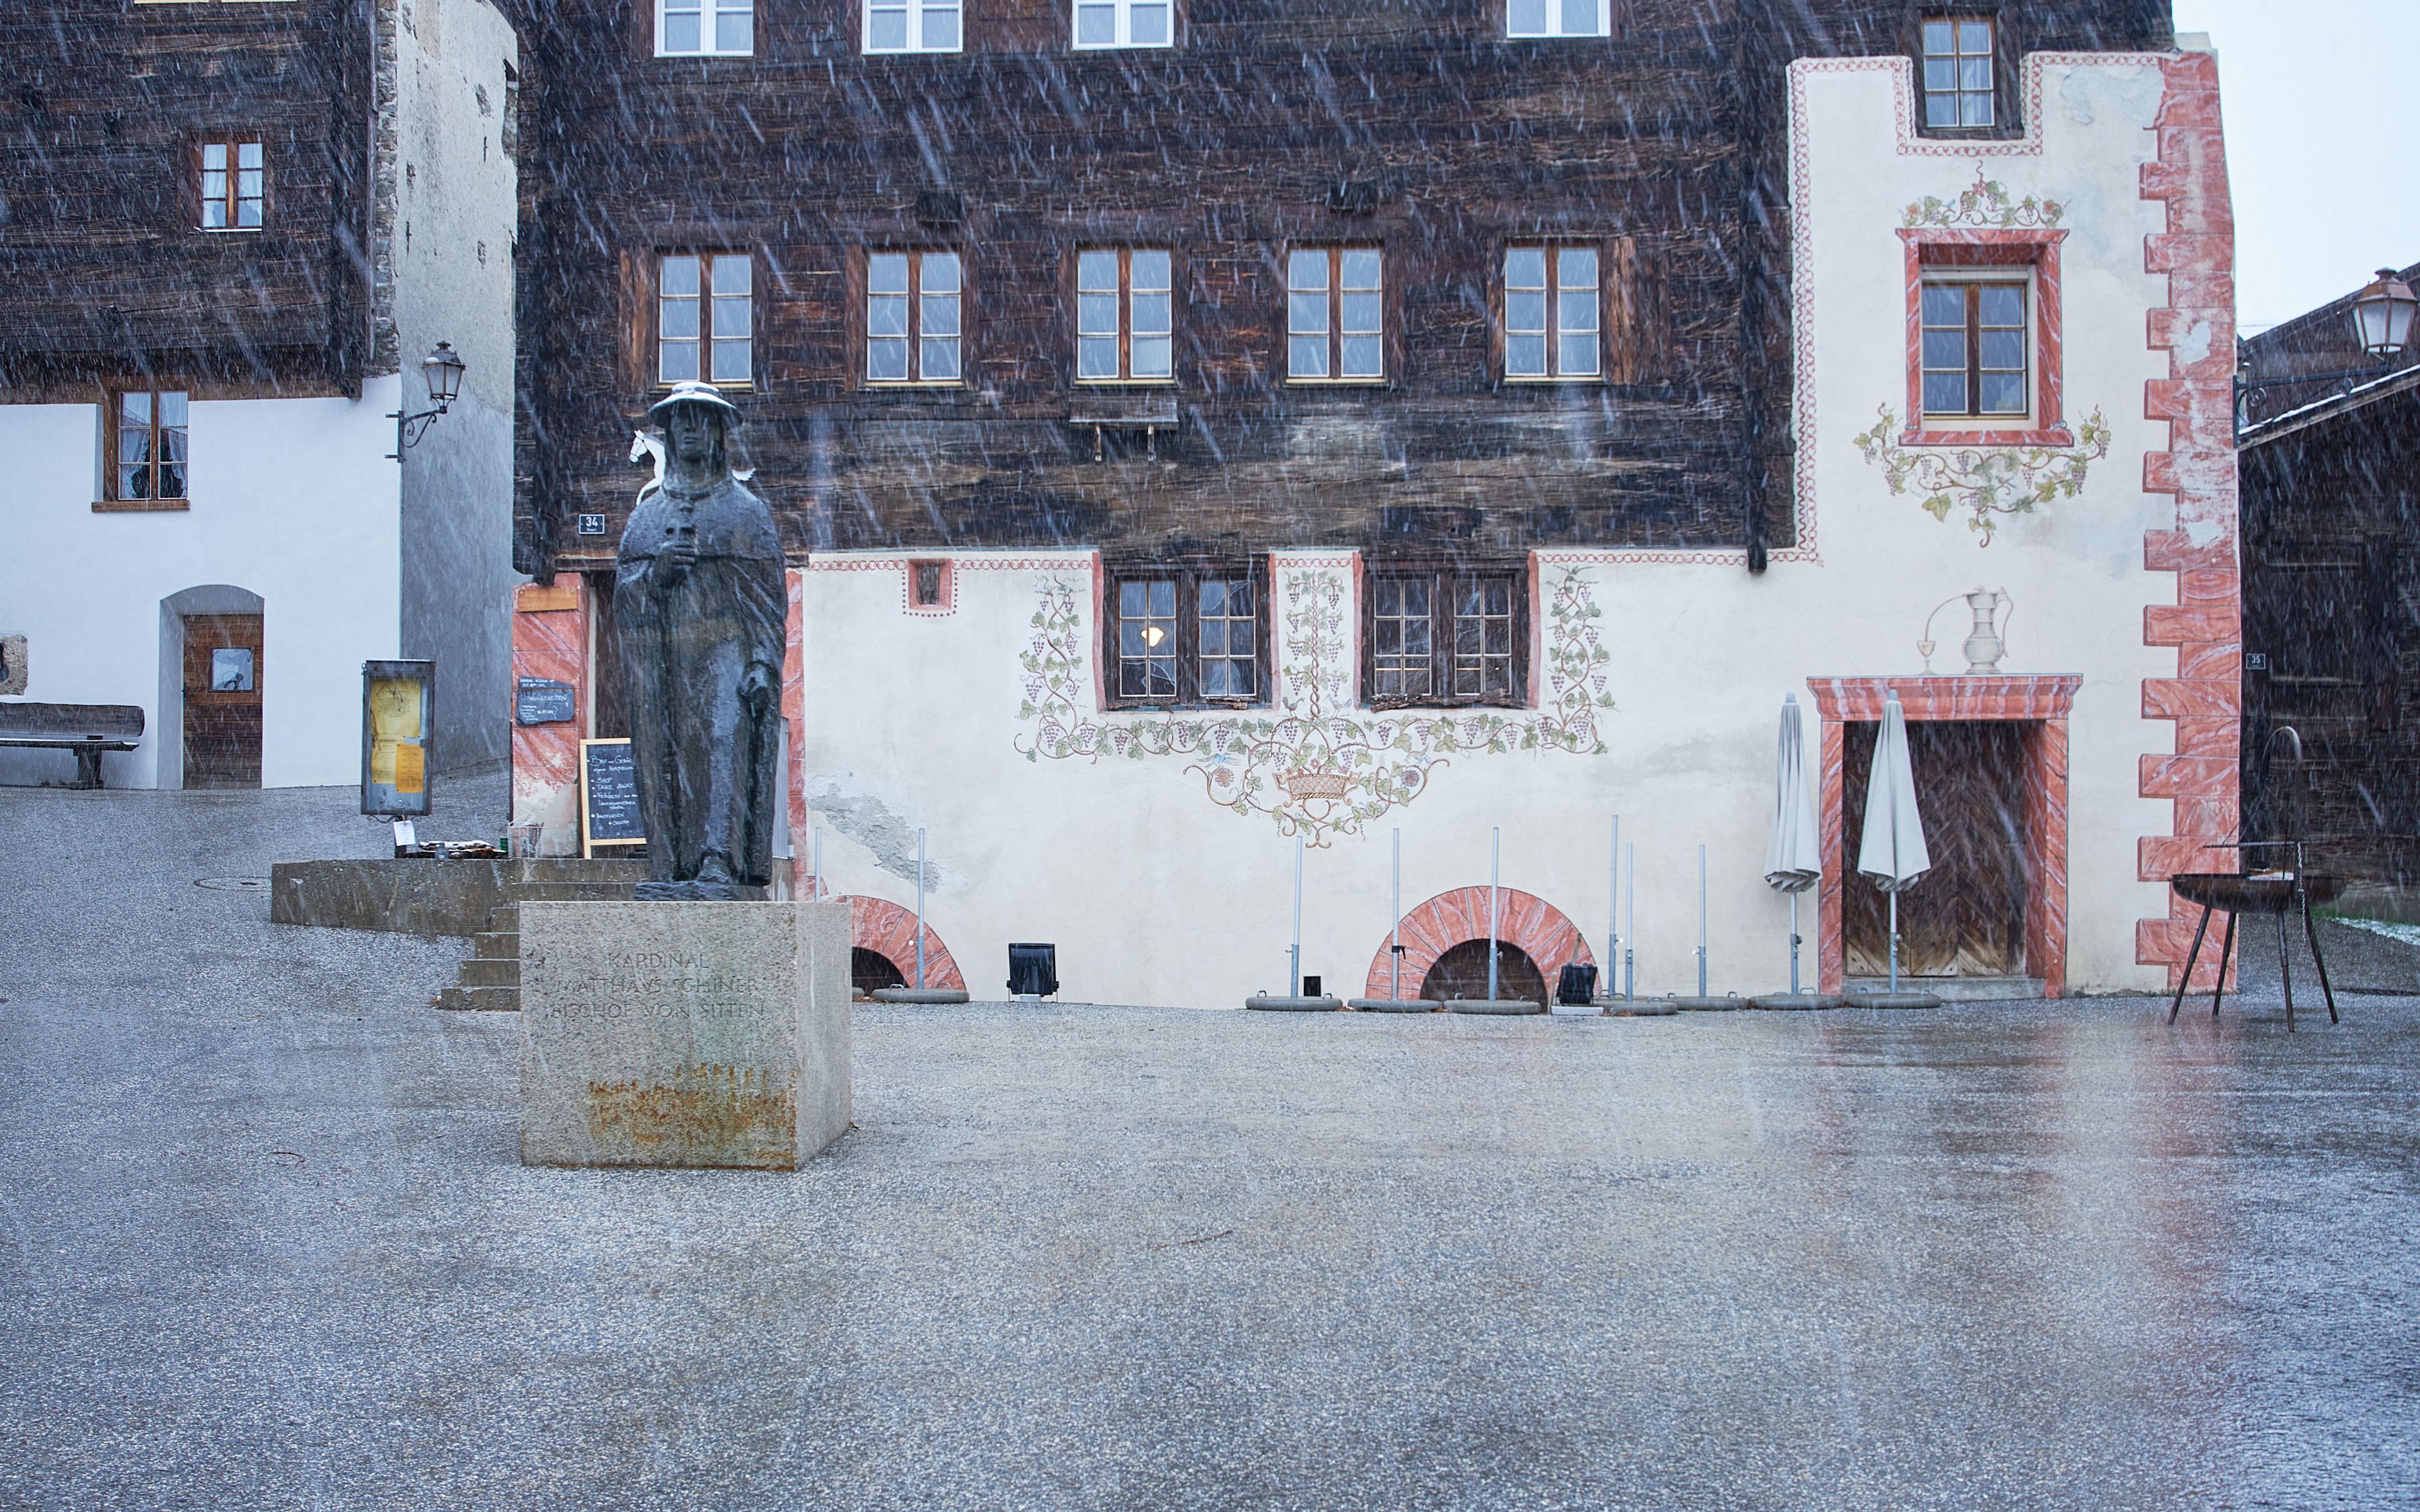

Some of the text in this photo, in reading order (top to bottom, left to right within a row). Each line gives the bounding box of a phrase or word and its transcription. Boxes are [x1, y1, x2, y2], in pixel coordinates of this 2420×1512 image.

[586, 517, 598, 527] 34
[2251, 655, 2261, 663] 35
[609, 953, 709, 968] KARDINAL
[672, 978, 758, 993] SCHINER
[551, 1003, 764, 1019] BISCHOF VON SITTEN
